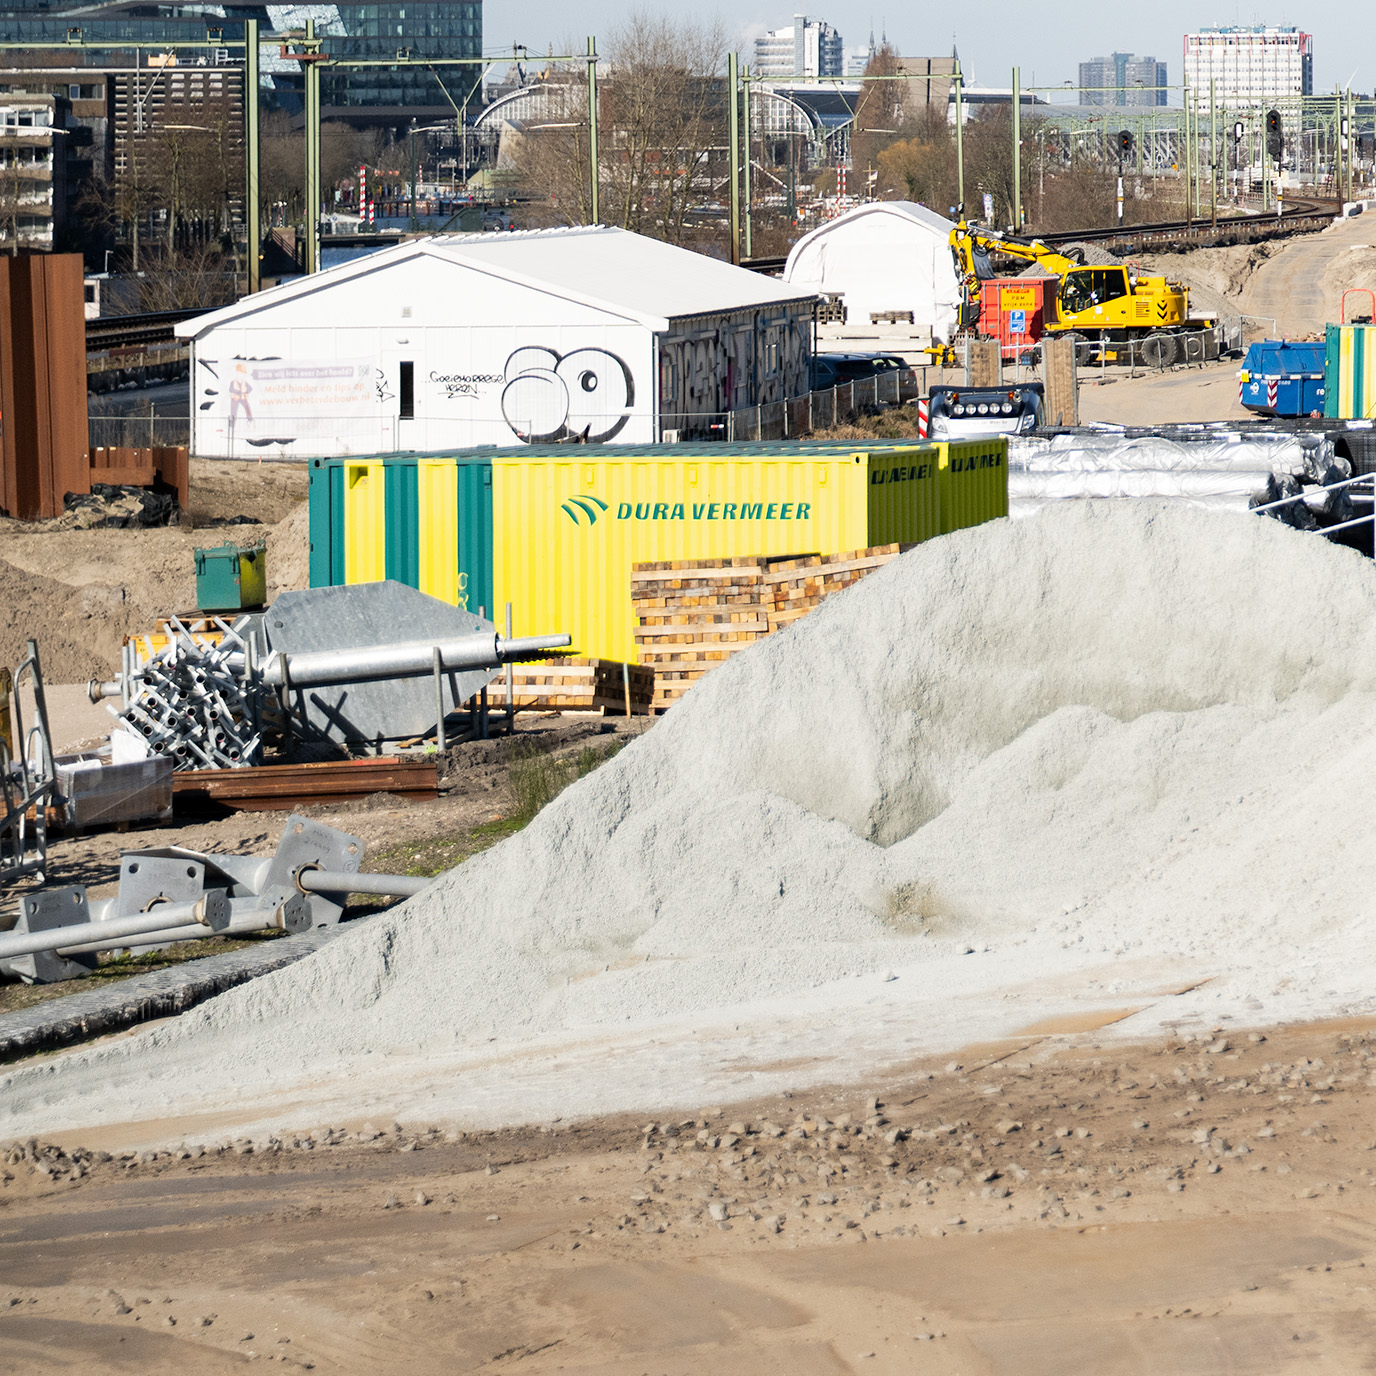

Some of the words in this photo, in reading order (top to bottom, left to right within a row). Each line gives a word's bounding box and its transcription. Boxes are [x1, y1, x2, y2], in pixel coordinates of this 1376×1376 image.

[264, 383, 286, 393] Meld
[288, 383, 318, 393] hinder
[320, 384, 332, 392] en
[334, 383, 351, 393] tips
[353, 383, 365, 392] op
[616, 502, 685, 520] DURA
[692, 502, 811, 520] VERMEER
